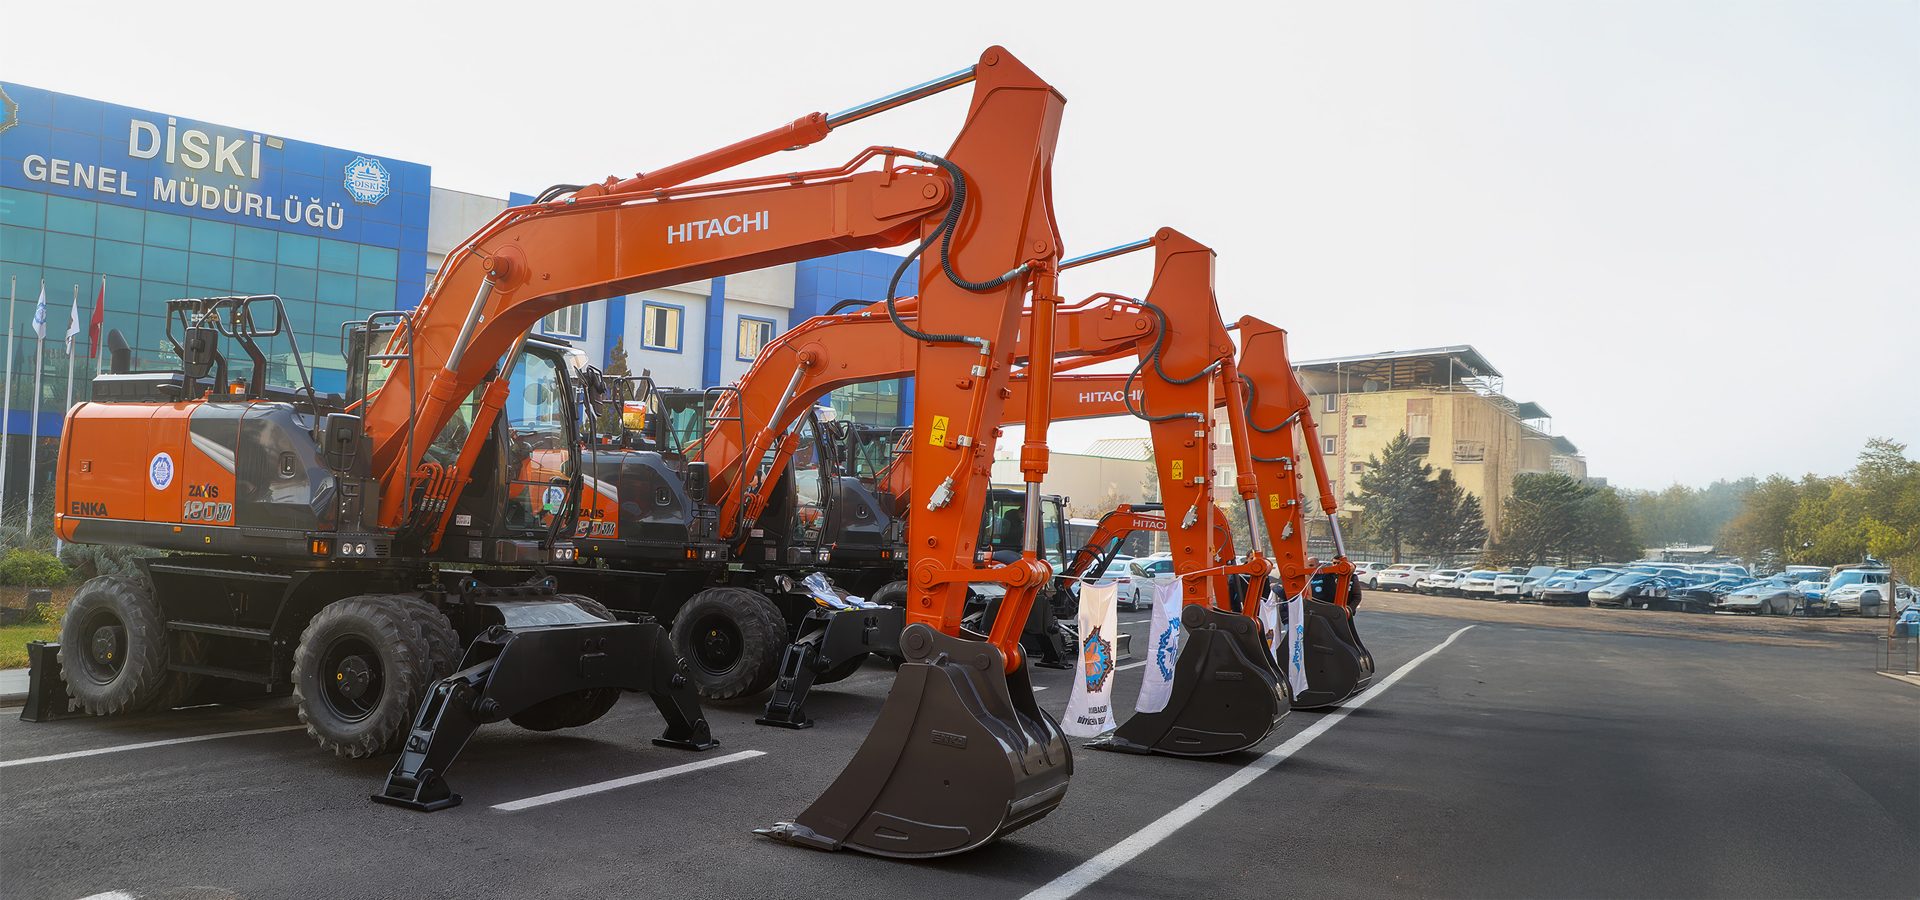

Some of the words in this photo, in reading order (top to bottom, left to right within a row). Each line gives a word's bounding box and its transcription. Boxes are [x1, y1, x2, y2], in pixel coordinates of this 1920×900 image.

[128, 117, 262, 180] DİSKİ
[23, 154, 137, 197] GENEL
[153, 176, 345, 231] MÜDÜRLÜĞÜ
[667, 210, 769, 245] HITACHI
[188, 483, 218, 498] ZAXIS
[71, 502, 108, 516] ENKA
[183, 500, 232, 523] 180W
